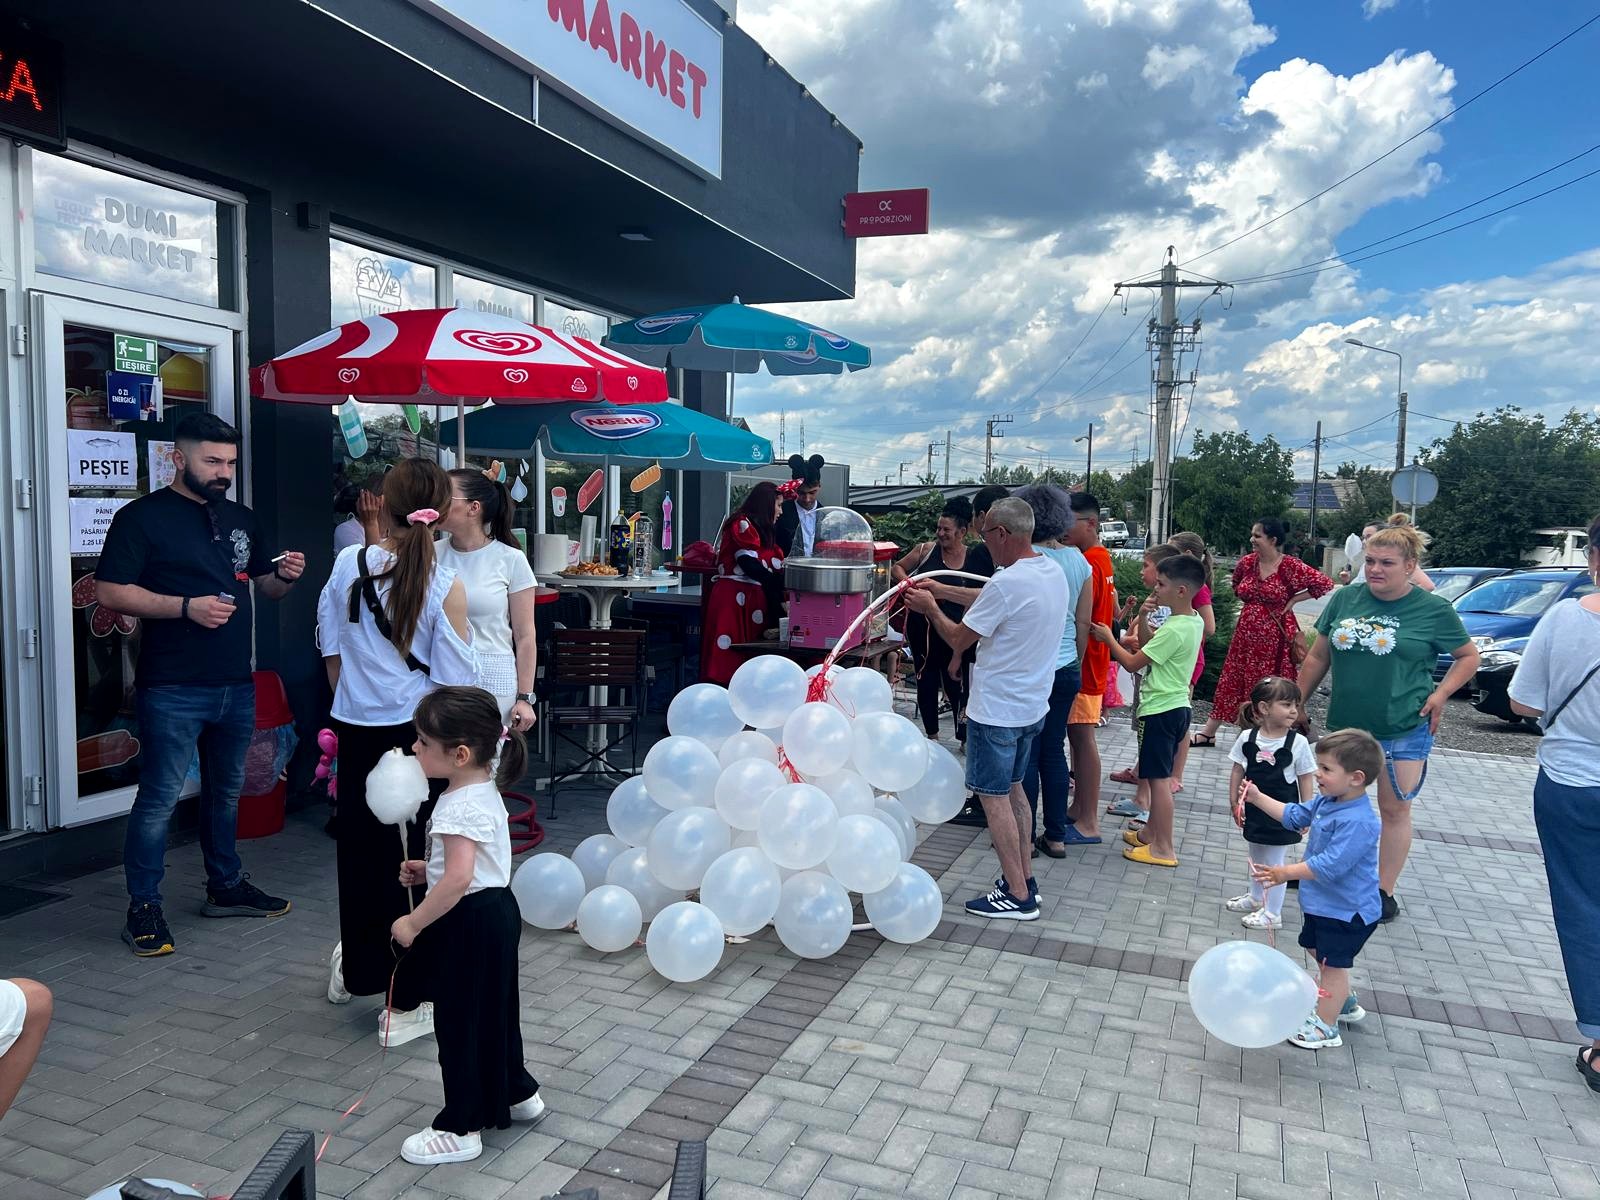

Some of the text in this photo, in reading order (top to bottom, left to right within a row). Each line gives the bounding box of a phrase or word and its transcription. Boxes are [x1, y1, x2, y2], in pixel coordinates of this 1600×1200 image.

[547, 0, 707, 119] MARKET
[104, 197, 177, 238] DUMI
[84, 226, 197, 272] MARKET
